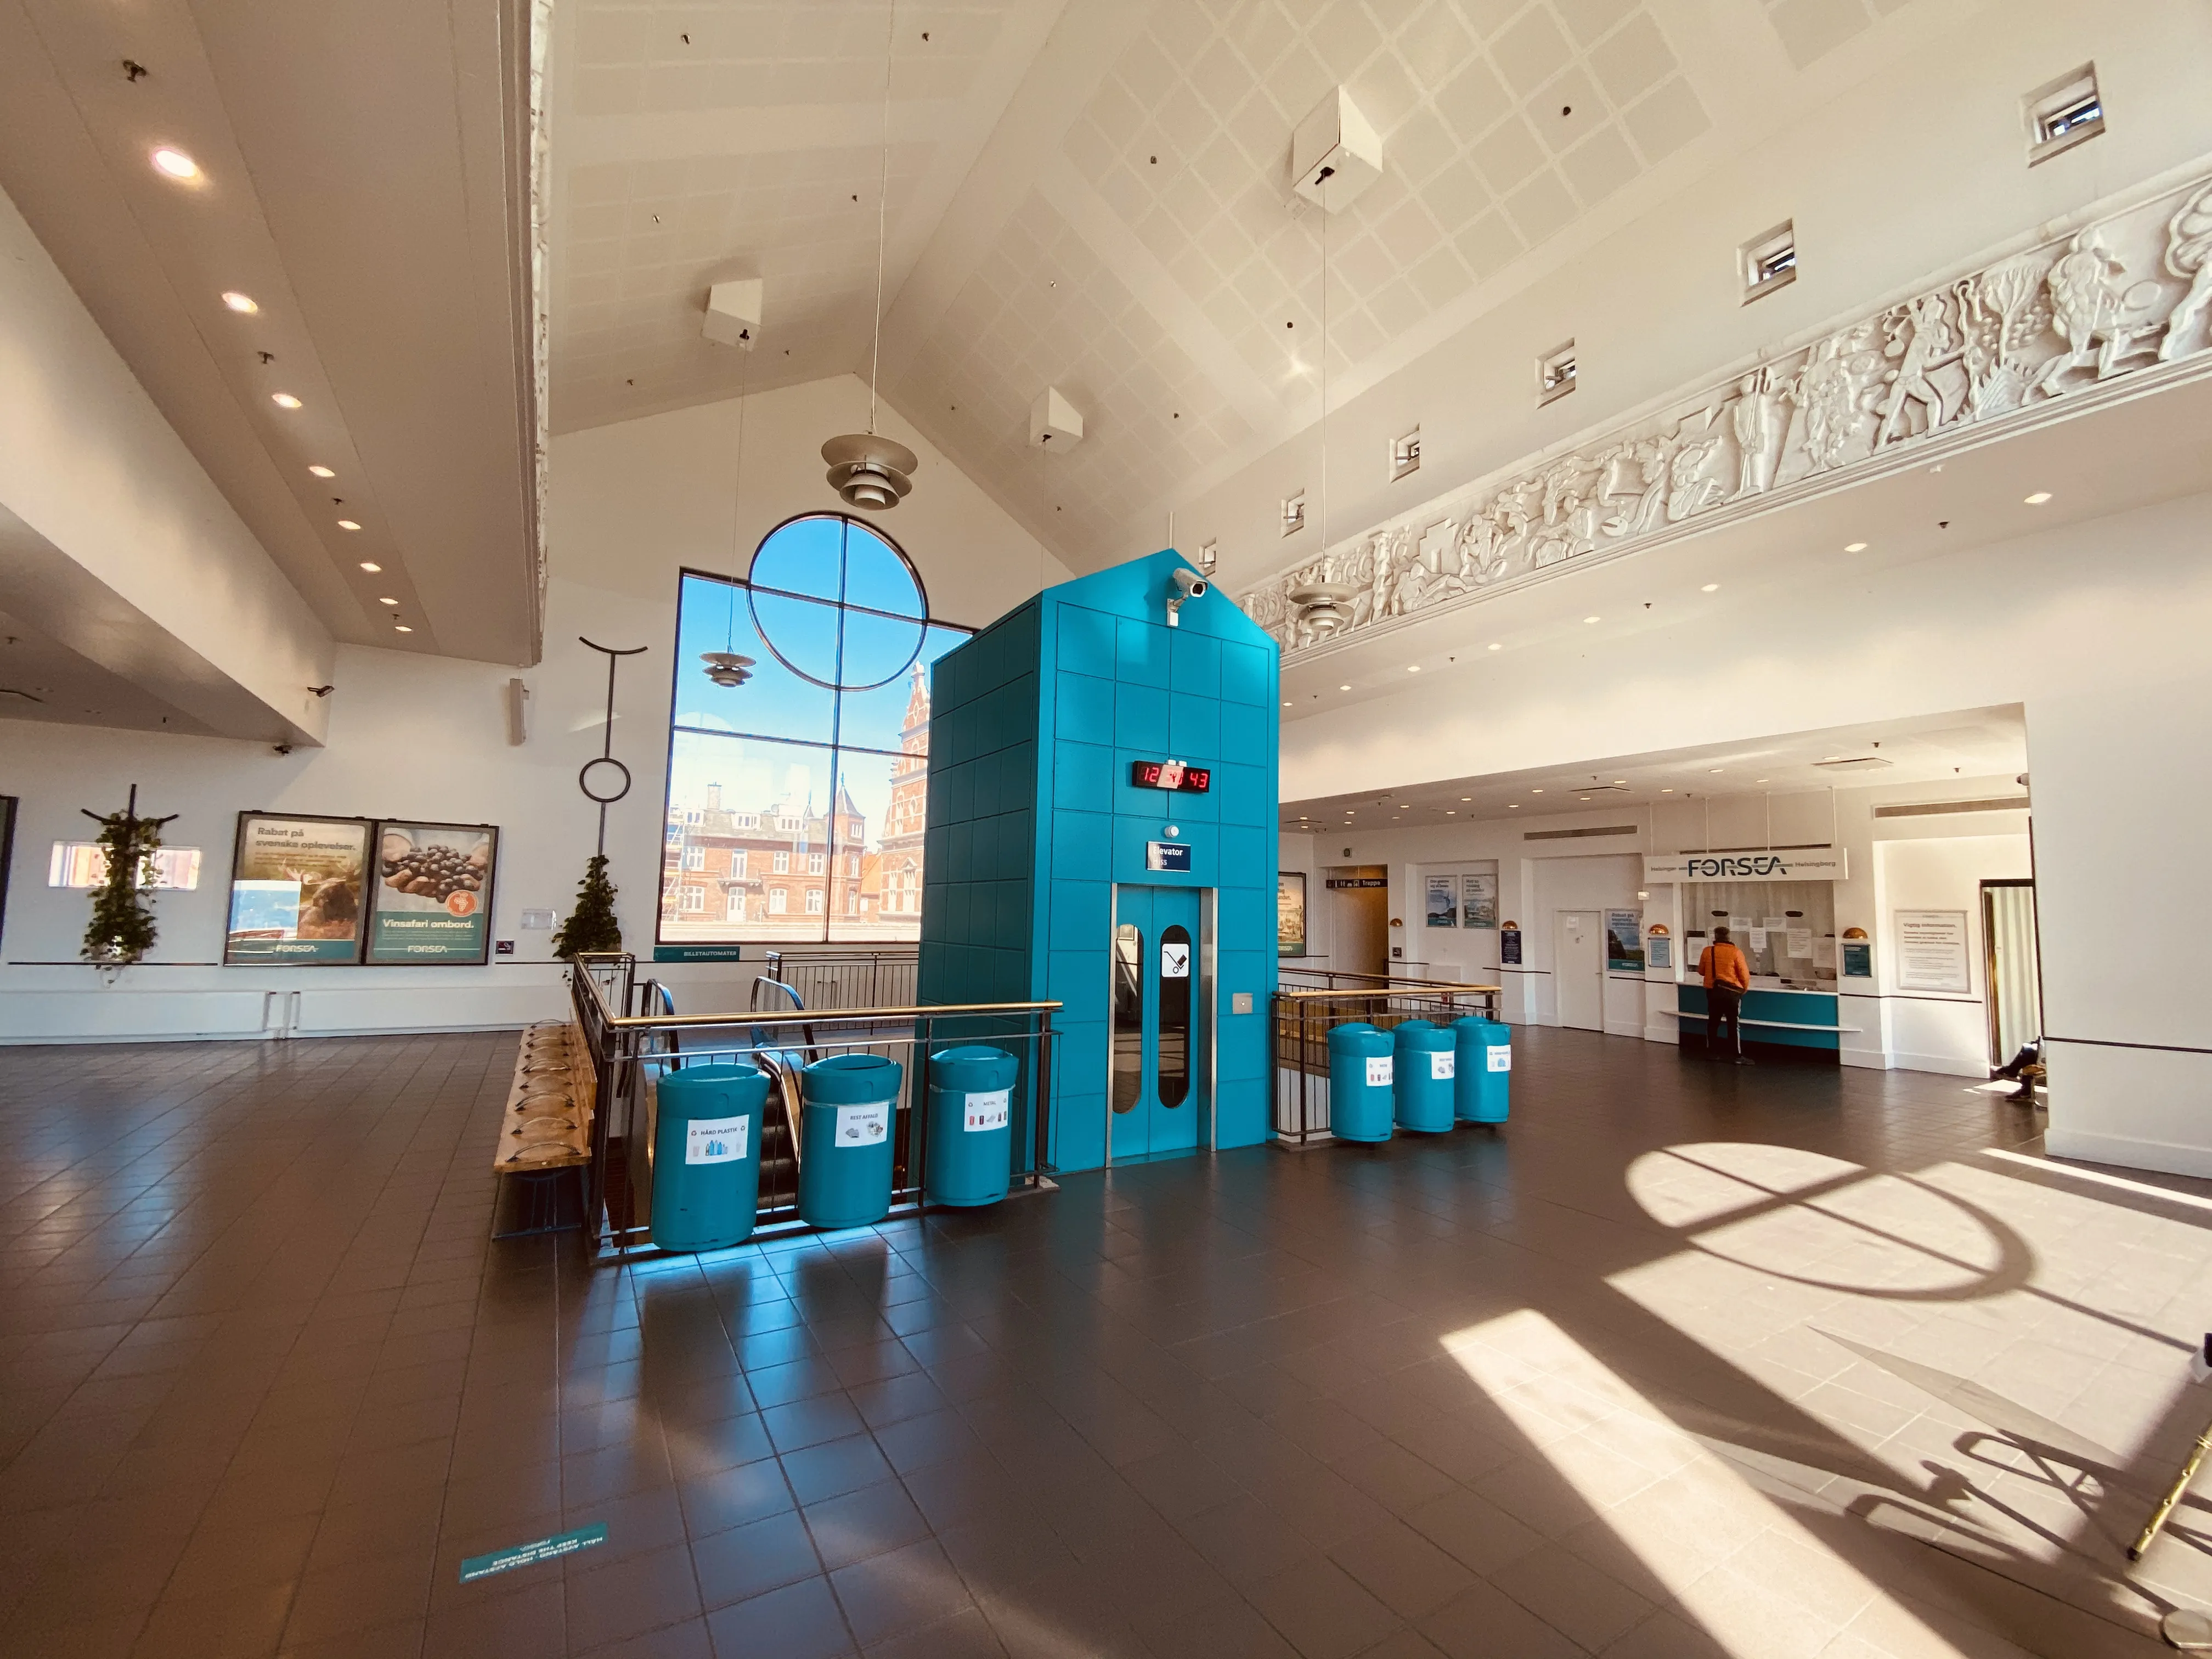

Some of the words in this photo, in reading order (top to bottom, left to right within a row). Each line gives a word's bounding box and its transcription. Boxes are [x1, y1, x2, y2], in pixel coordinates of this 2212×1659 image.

[1144, 766, 1159, 782] 12
[1190, 772, 1208, 788] 43
[257, 827, 289, 836] Rabat
[291, 829, 304, 838] på
[1152, 846, 1183, 856] Elevator
[1152, 857, 1168, 866] Hiss
[1688, 856, 1787, 877] FORSEA
[382, 919, 428, 928] Vinsafari
[430, 920, 474, 928] ombord.
